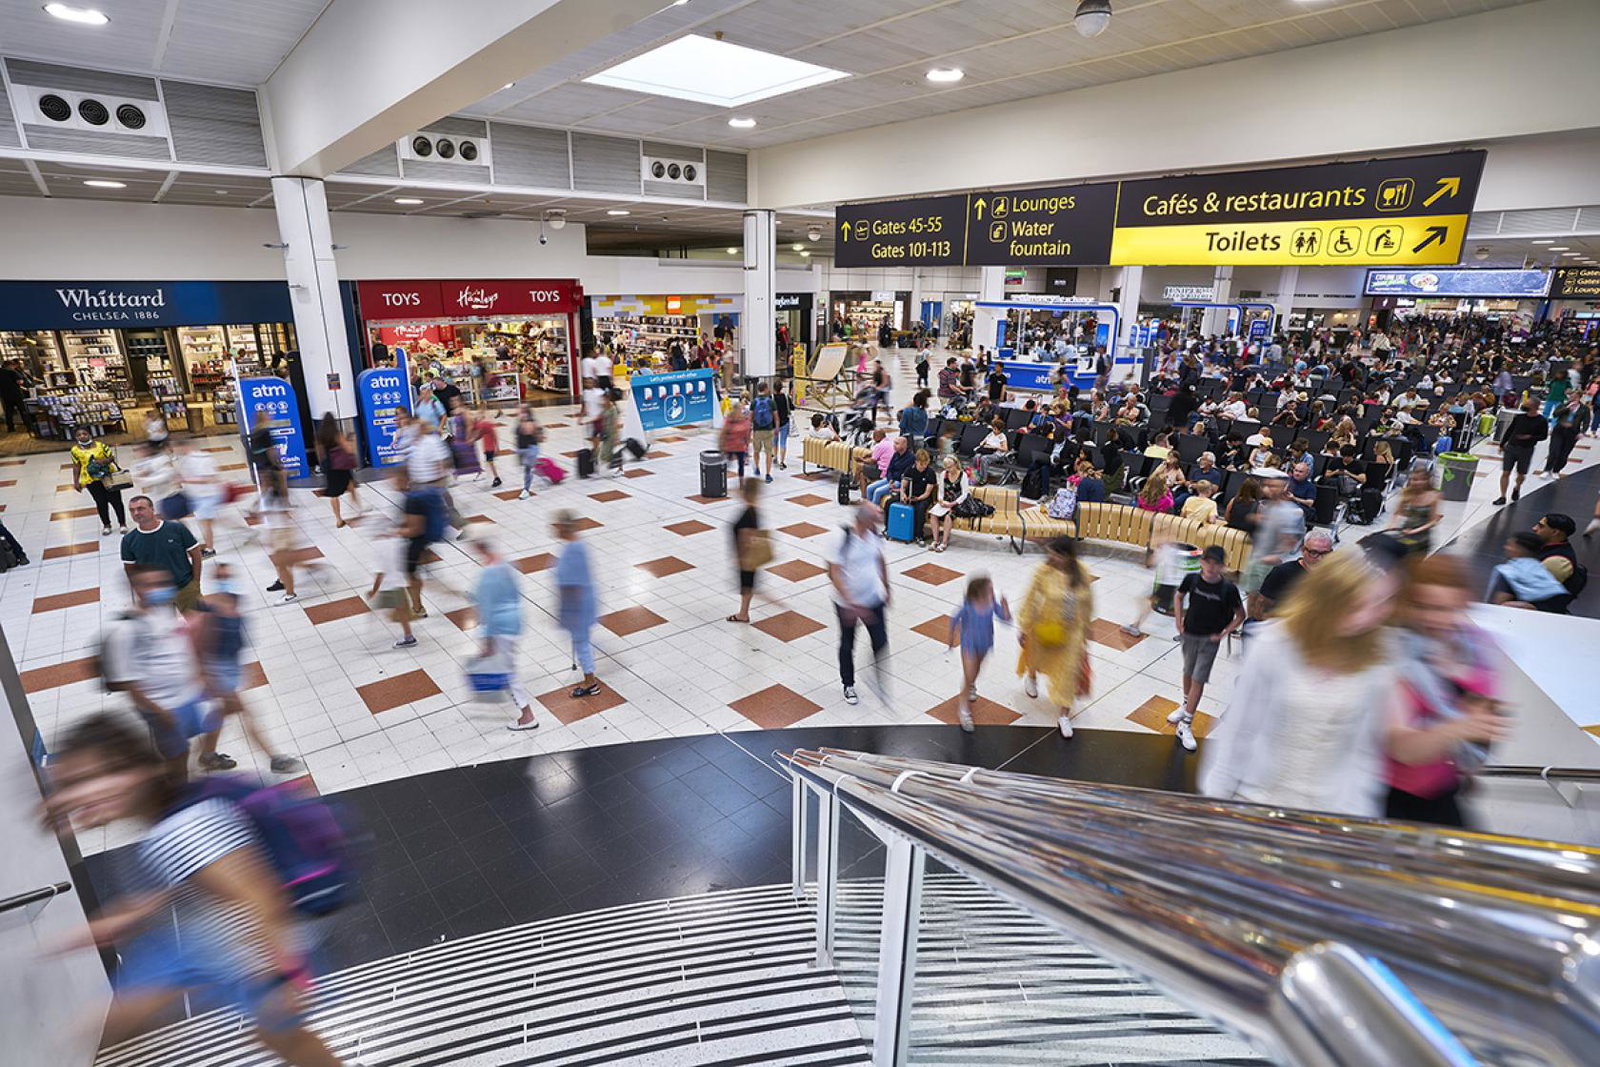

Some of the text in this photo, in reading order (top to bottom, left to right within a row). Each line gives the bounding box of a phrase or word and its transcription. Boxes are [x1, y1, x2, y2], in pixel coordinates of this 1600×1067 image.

[1012, 195, 1076, 214] Lounges
[1143, 186, 1367, 216] Cafés & restaurants
[872, 216, 943, 236] Gates 45-55
[1012, 221, 1054, 236] Water
[871, 241, 951, 259] Gates 101-113
[1010, 239, 1071, 257] fountain
[1205, 231, 1281, 251] Toilets
[56, 289, 166, 307] Whittard
[382, 285, 560, 309] TOYS Hamleys TOYS
[72, 311, 160, 321] CHELSEA 1886
[252, 384, 286, 398] atm
[370, 376, 400, 389] atm
